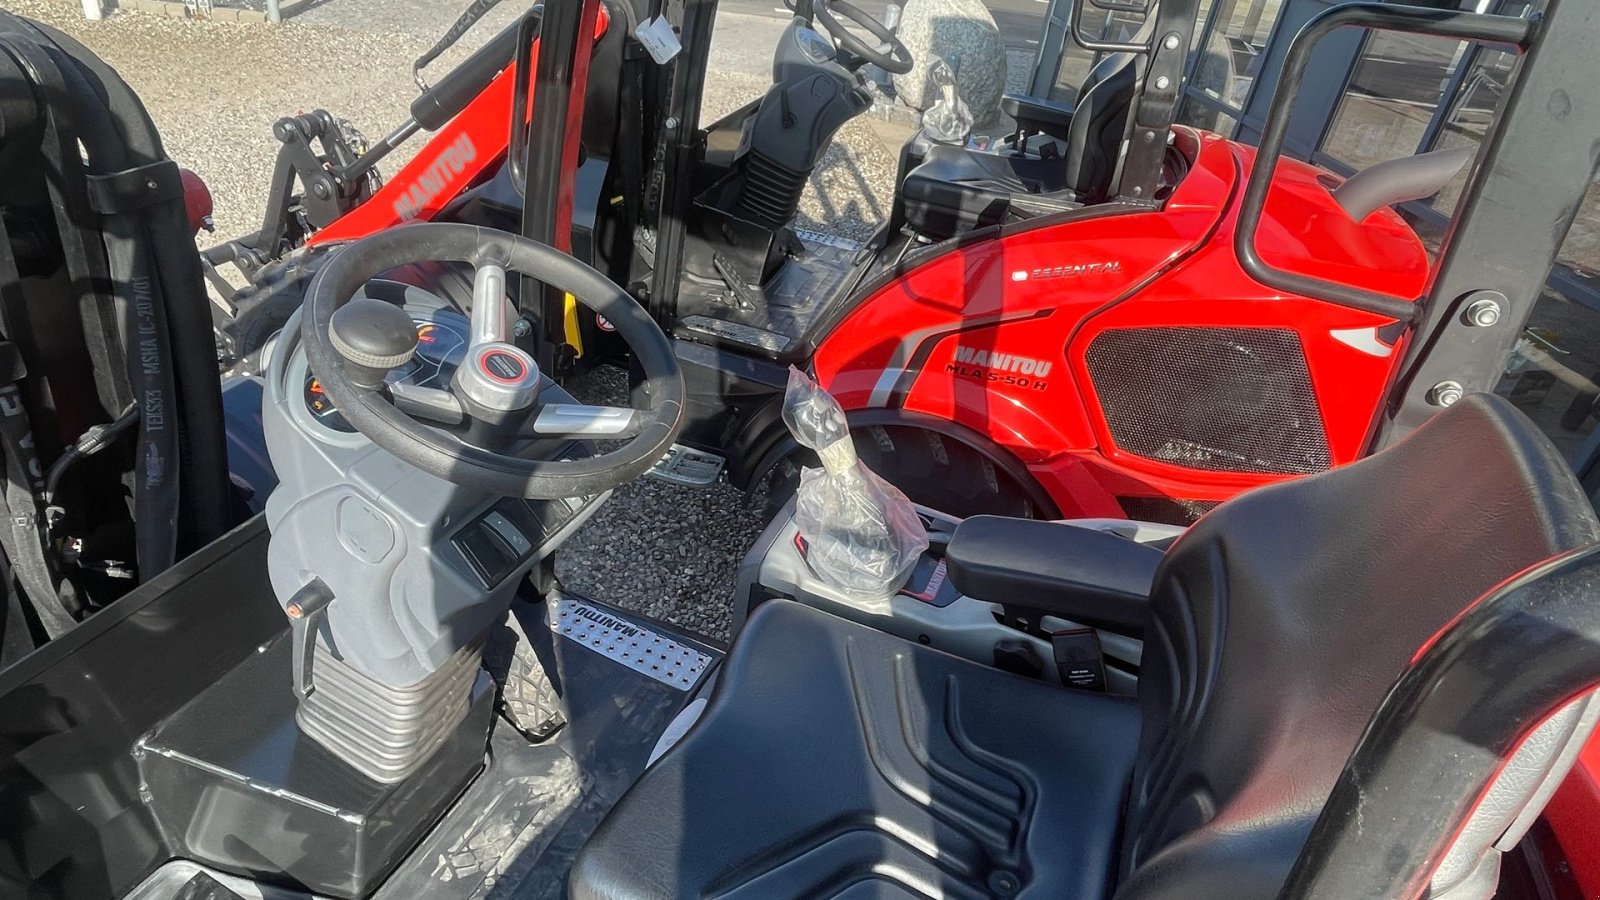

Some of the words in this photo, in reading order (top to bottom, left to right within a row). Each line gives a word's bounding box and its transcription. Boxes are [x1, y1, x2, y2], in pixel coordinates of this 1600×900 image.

[394, 131, 477, 222] MANITOU
[1032, 262, 1121, 279] ESSENTIAL
[140, 337, 160, 375] MSHA
[955, 345, 1053, 377] MANITOU
[945, 364, 982, 379] MLA
[986, 372, 1030, 387] 5-50
[1032, 381, 1048, 391] H
[573, 606, 639, 638] MANITOU
